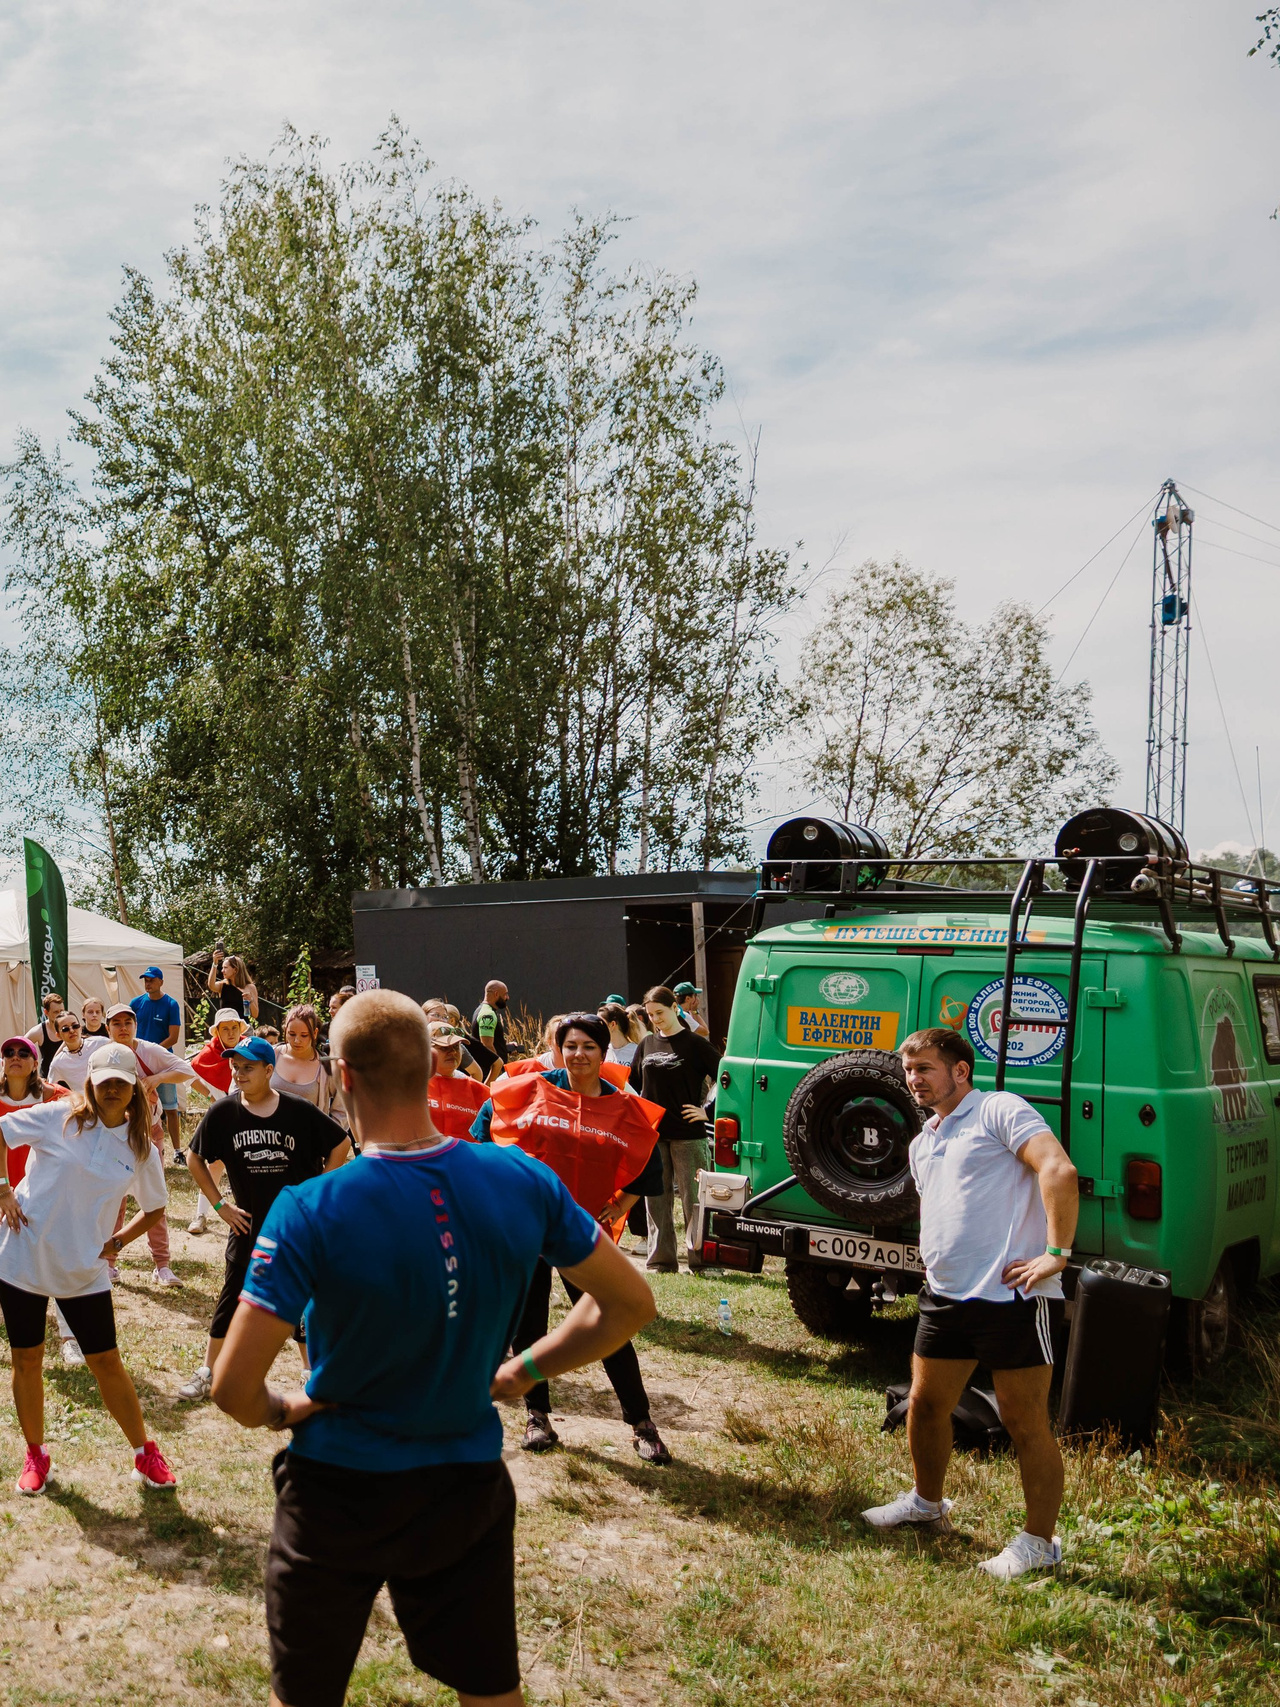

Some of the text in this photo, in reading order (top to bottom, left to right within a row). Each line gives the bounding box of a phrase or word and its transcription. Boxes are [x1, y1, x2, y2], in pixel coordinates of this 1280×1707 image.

[973, 976, 1068, 1015] ВАЛЕНТН ЕФРЕМОВ
[1012, 998, 1052, 1007] ОВГОРОД-
[799, 1011, 881, 1030] ВАЛЕНТИН
[968, 1012, 977, 1029] 800
[1019, 1006, 1055, 1015] ЧУКОТКА
[802, 1027, 874, 1046] ЕФРЕМОВ
[969, 1030, 985, 1047] ЛЕТ
[1032, 1026, 1067, 1066] НОВГОРО
[981, 1046, 1030, 1066] НИЖЕМУ
[446, 1103, 478, 1116] волонтер
[232, 1129, 282, 1151] AUTHENTIC
[536, 1115, 629, 1148] ПСБ волонтеры
[1226, 1138, 1268, 1174] ТЕРРИТОРИЯ
[809, 1165, 905, 1203] MAXXIS
[1226, 1174, 1267, 1212] МАМОНТОВ
[430, 1188, 459, 1318] RUSSIA
[905, 1262, 921, 1270] RUS
